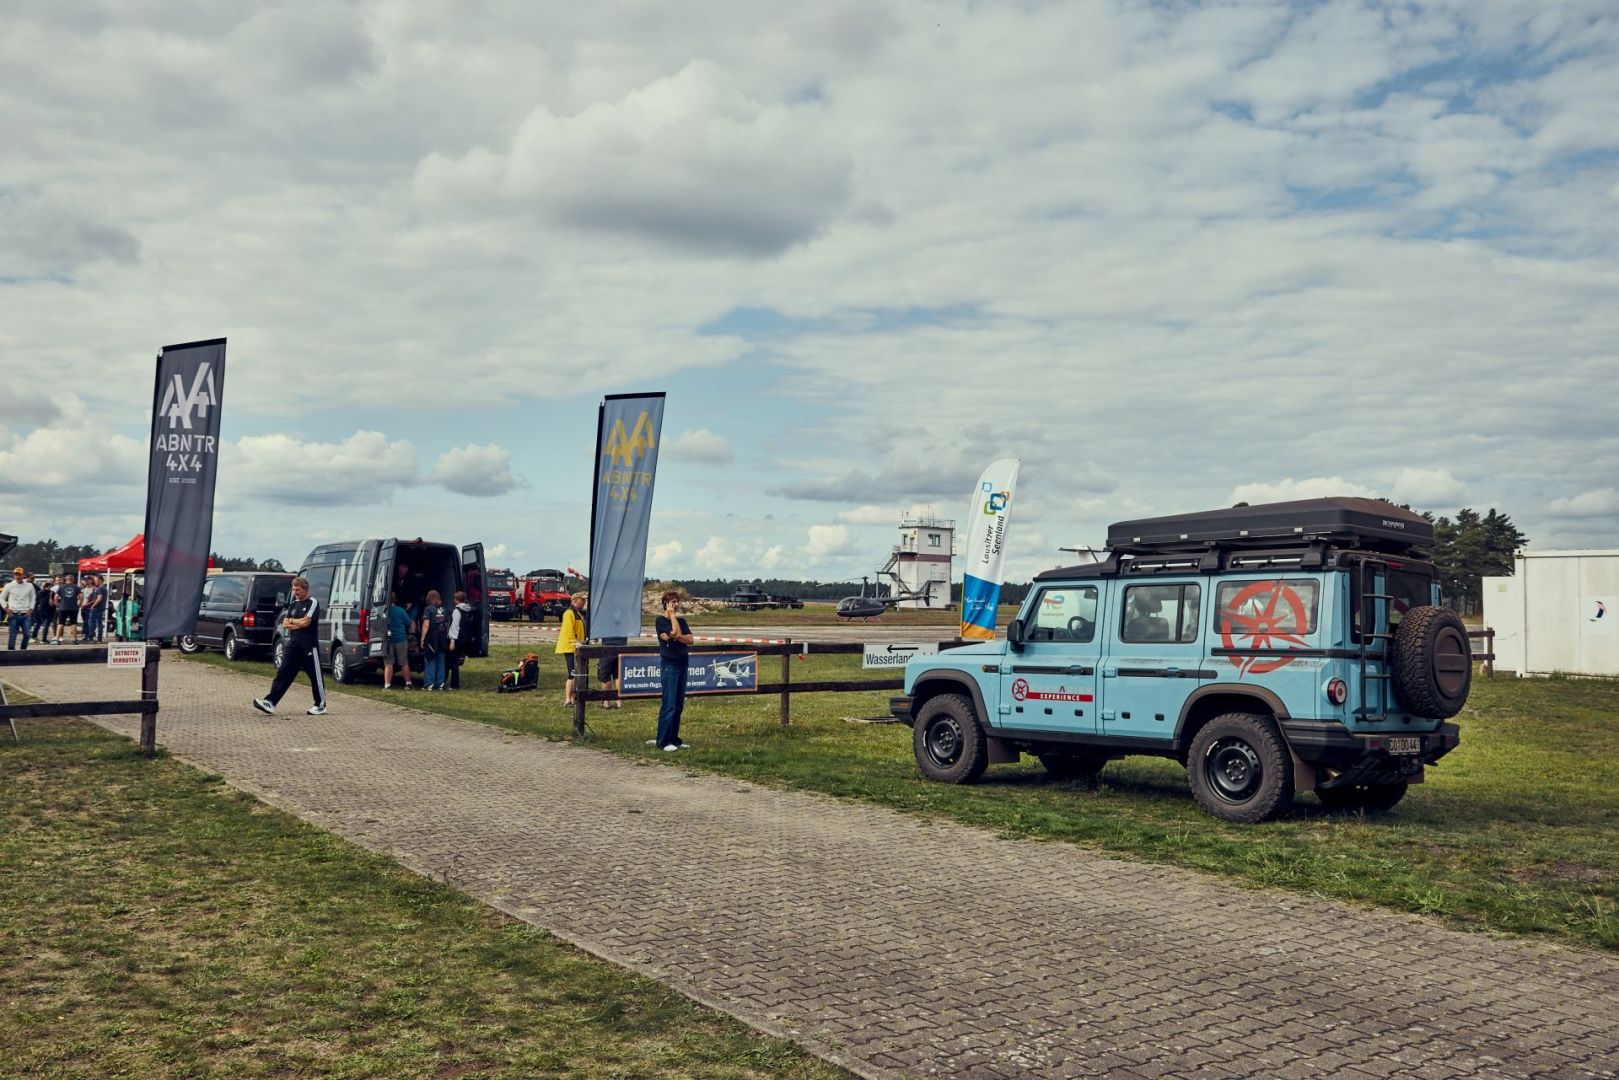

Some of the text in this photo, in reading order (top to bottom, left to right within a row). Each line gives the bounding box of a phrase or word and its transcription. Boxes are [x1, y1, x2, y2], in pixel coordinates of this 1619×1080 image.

[156, 433, 215, 453] ABNTR
[602, 470, 652, 487] ABNTR
[982, 524, 994, 564] Lausitzer
[991, 515, 1004, 556] Seenland
[624, 666, 646, 680] jetzt
[647, 665, 661, 677] flie
[1040, 693, 1080, 701] EXPERIENCE
